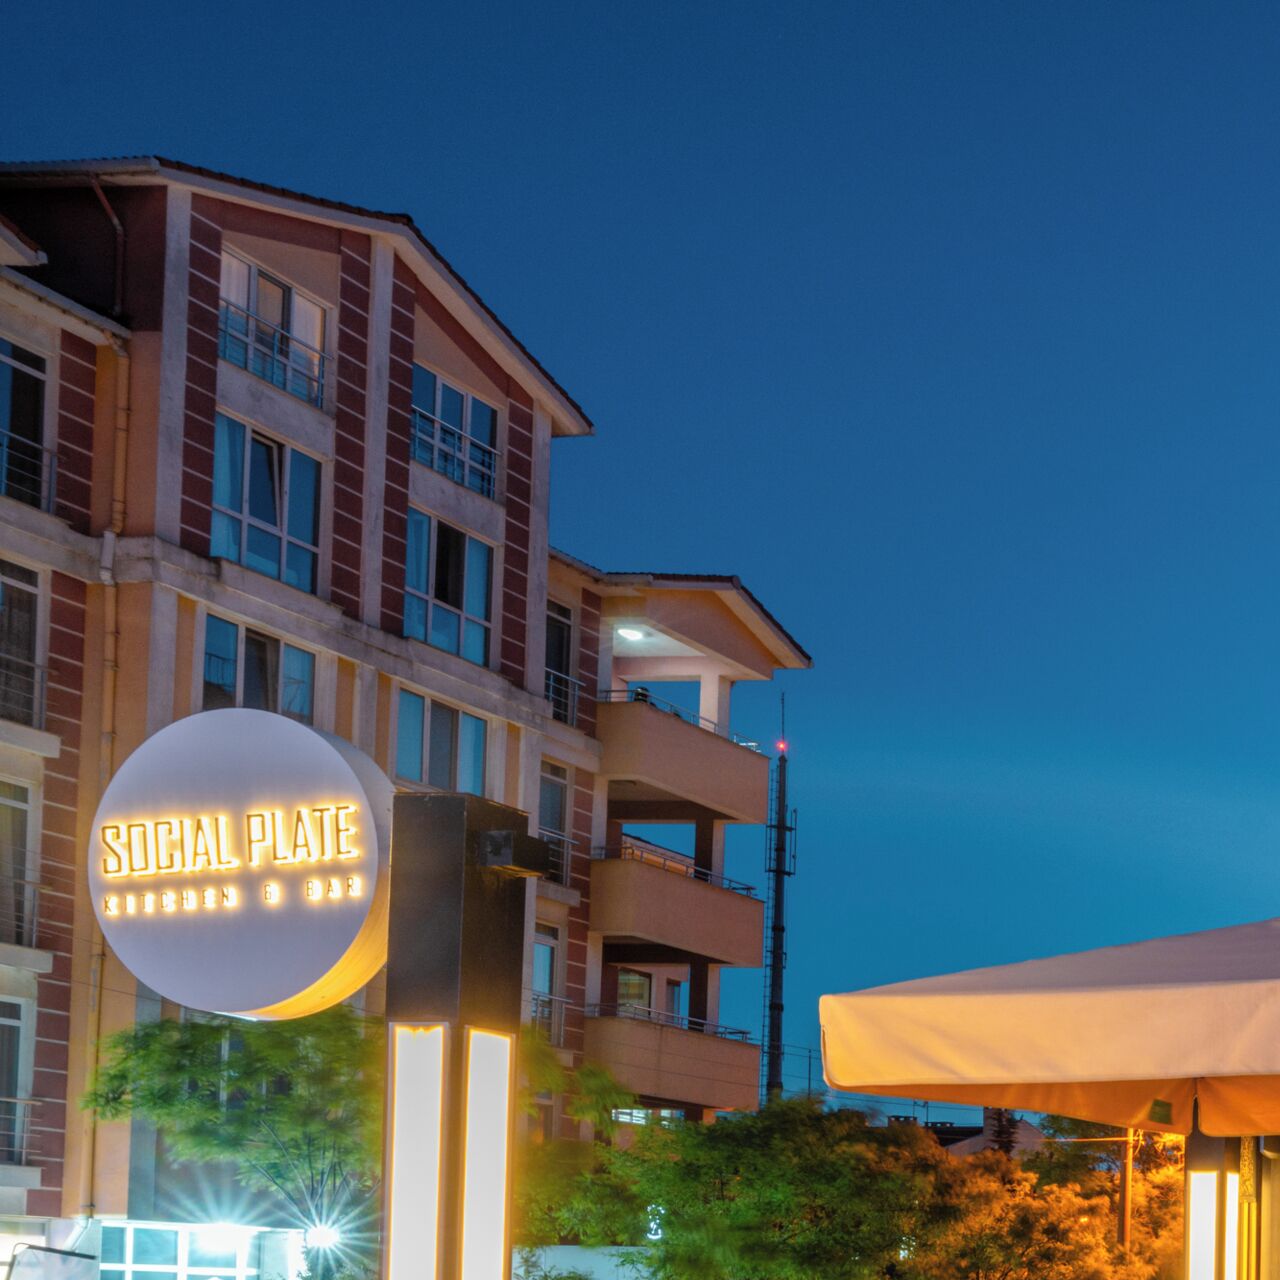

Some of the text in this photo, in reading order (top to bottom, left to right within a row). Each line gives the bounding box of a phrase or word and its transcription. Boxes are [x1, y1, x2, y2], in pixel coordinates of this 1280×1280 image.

[101, 805, 360, 876] SOCIAL PLATE
[104, 887, 236, 914] KITCHEN
[306, 876, 362, 899] BAR
